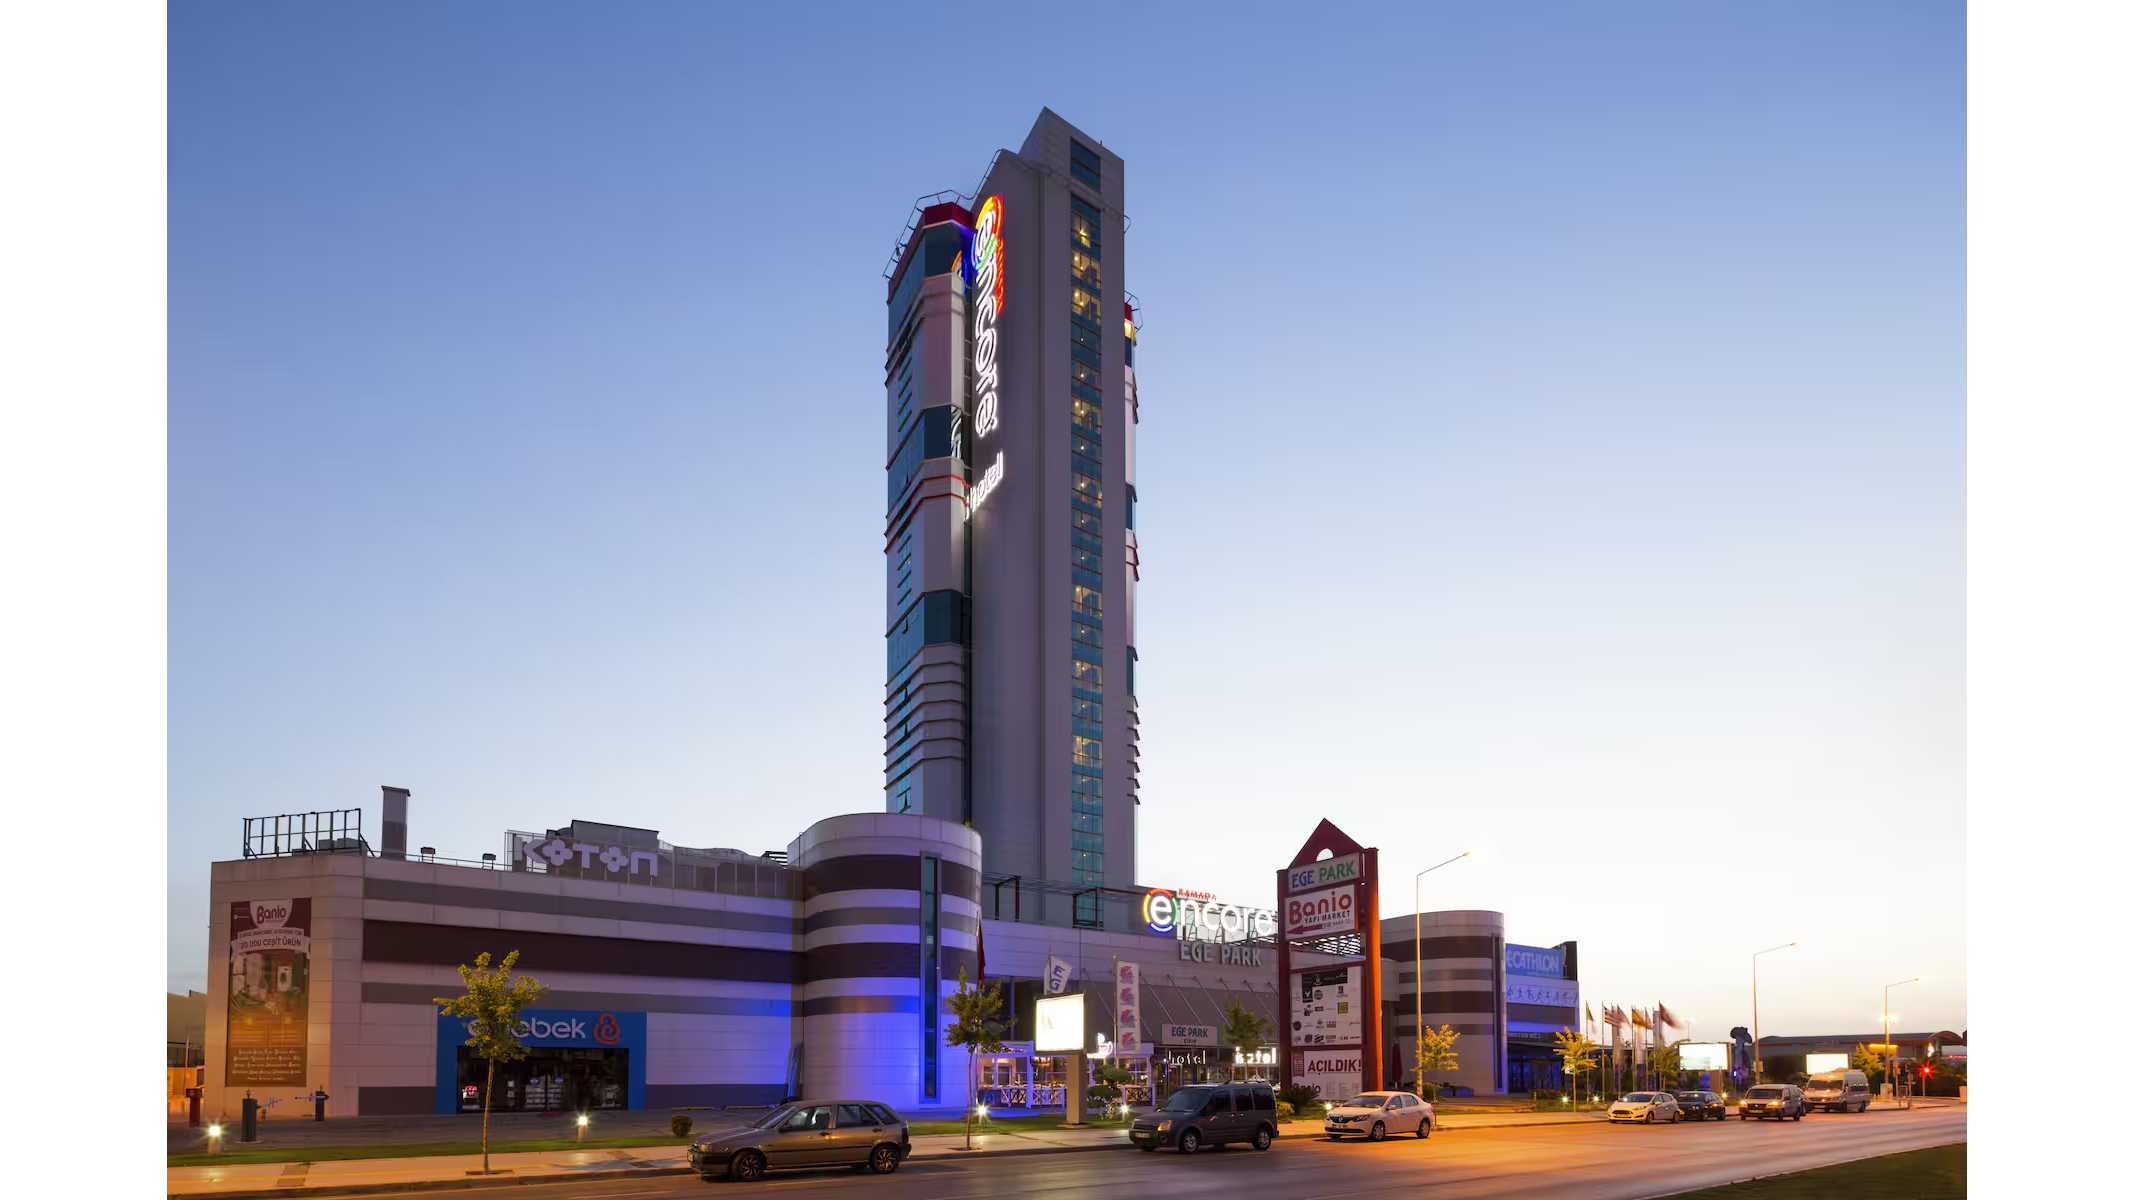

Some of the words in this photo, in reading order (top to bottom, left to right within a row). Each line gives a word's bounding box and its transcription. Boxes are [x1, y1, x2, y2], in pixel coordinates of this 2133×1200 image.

[975, 209, 998, 437] encore
[1291, 869, 1315, 889] EGE
[1318, 860, 1355, 881] PARK
[1178, 888, 1217, 901] RAMADA
[256, 906, 287, 925] Banio
[1149, 895, 1275, 937] encore
[1289, 891, 1352, 925] Banio
[1304, 916, 1320, 925] YAPI
[1321, 910, 1351, 921] MARKET
[1180, 940, 1213, 962] EGE
[1221, 944, 1261, 967] PARK
[1506, 949, 1559, 974] ECATHLON
[1171, 1026, 1187, 1037] EGE
[1188, 1027, 1209, 1038] PARK
[1307, 1059, 1362, 1075] AÇILDIK!
